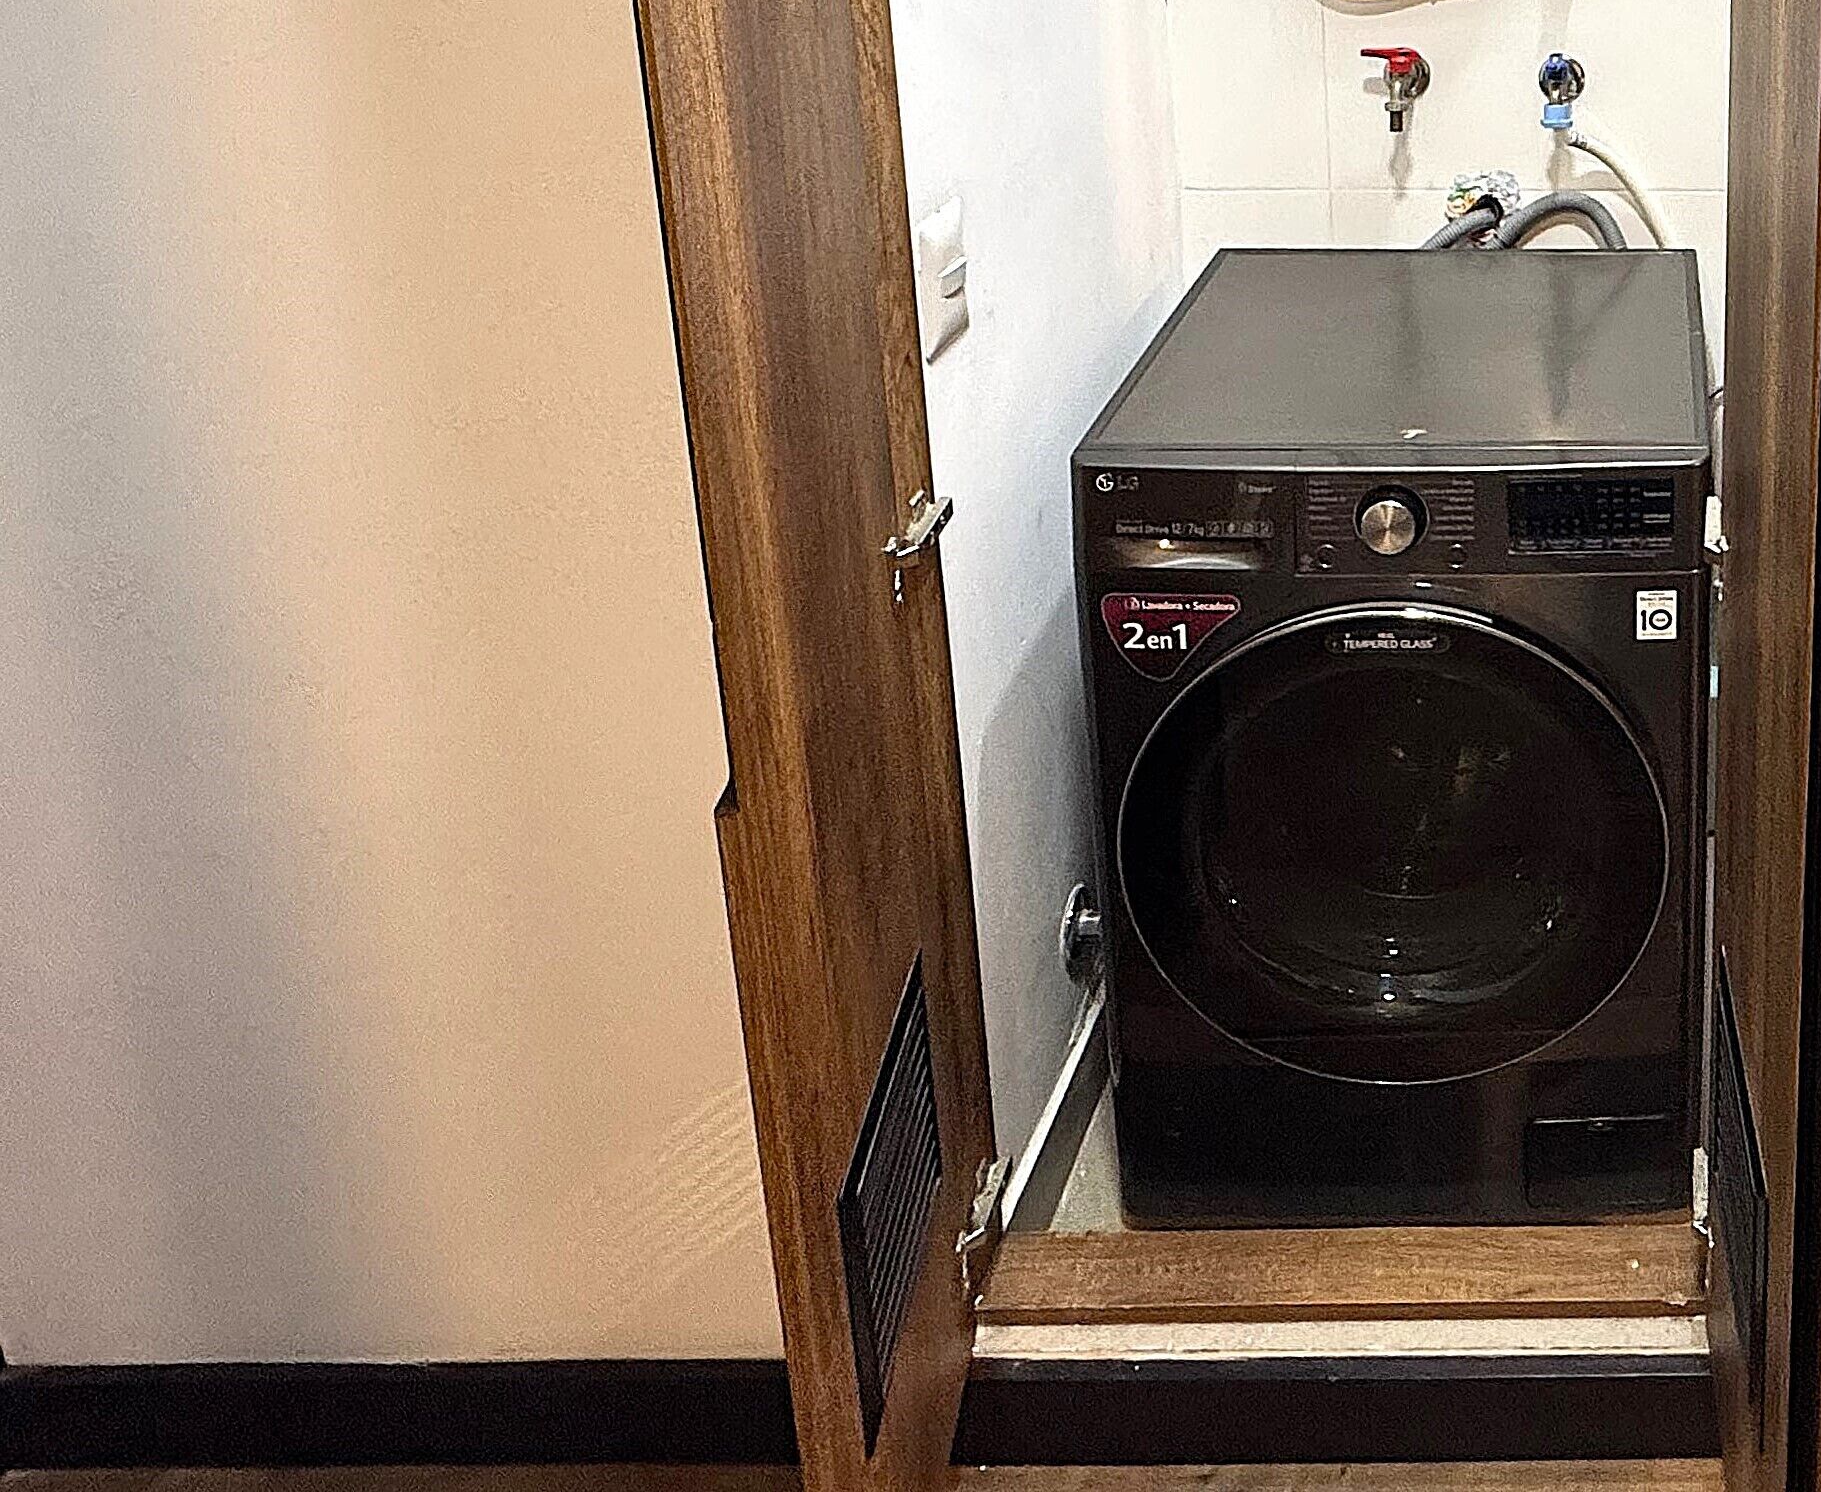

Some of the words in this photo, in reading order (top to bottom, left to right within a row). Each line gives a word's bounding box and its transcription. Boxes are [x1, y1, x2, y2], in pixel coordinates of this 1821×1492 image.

[1117, 475, 1139, 491] LG
[1343, 639, 1399, 649] TEMPERED
[1399, 639, 1434, 649] GLASS
